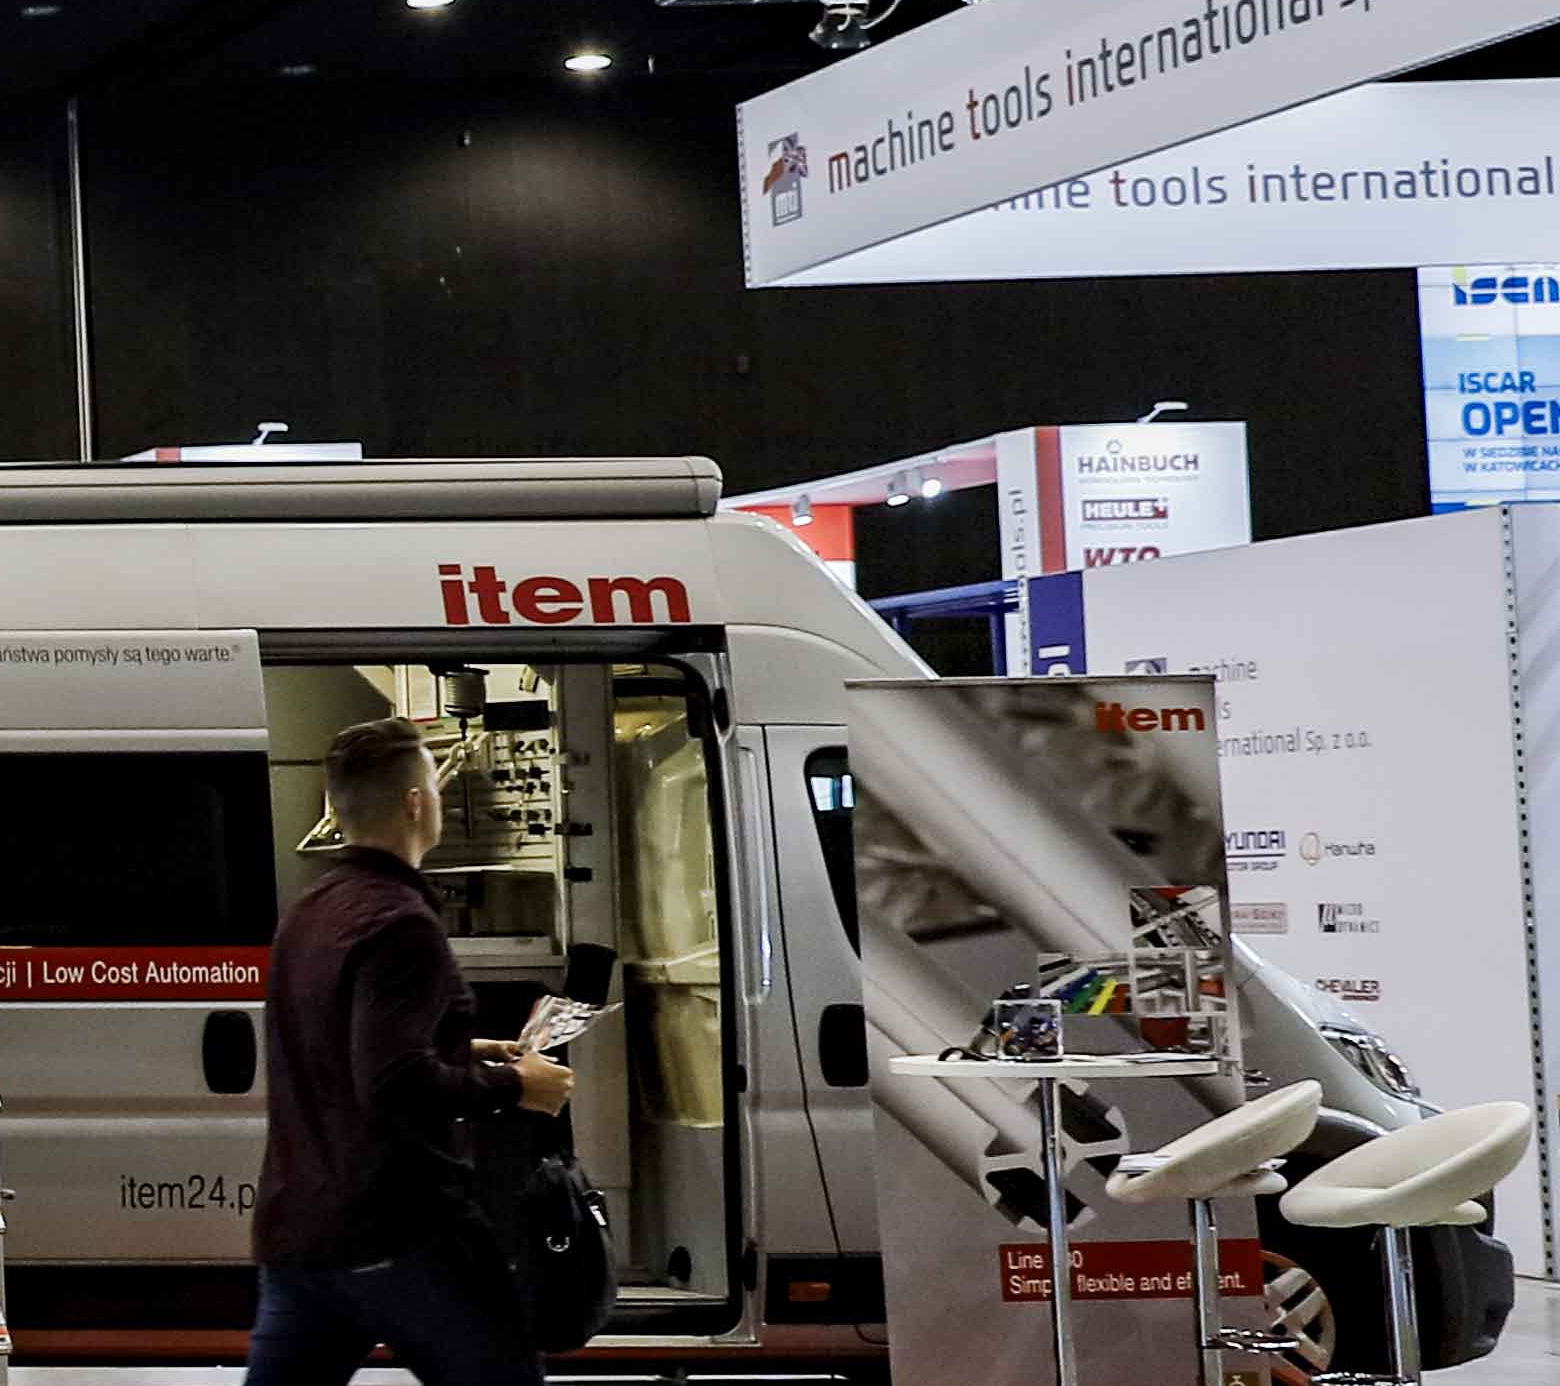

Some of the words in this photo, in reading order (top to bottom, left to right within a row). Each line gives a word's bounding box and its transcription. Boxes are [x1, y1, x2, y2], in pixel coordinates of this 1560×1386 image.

[828, 103, 955, 195] machine
[968, 66, 1053, 143] tools
[1110, 167, 1227, 209] tools
[1248, 156, 1556, 206] international
[1458, 371, 1536, 394] ISCAR
[1077, 454, 1200, 474] HAINBUCH
[1085, 502, 1155, 519] HEULE
[438, 563, 692, 626] item
[53, 646, 119, 667] pomysły
[122, 647, 141, 666] są
[146, 646, 181, 666] tego
[1095, 701, 1205, 732] item
[1216, 726, 1301, 758] ernational
[1224, 830, 1286, 851] YUNDAI
[43, 961, 84, 984] Low
[91, 959, 139, 984] Cost
[145, 959, 259, 983] Automation
[121, 1174, 256, 1216] item24.p
[1007, 1250, 1044, 1270] Line
[1009, 1275, 1053, 1297] Simp
[1077, 1273, 1135, 1293] flexible
[1140, 1272, 1172, 1291] and
